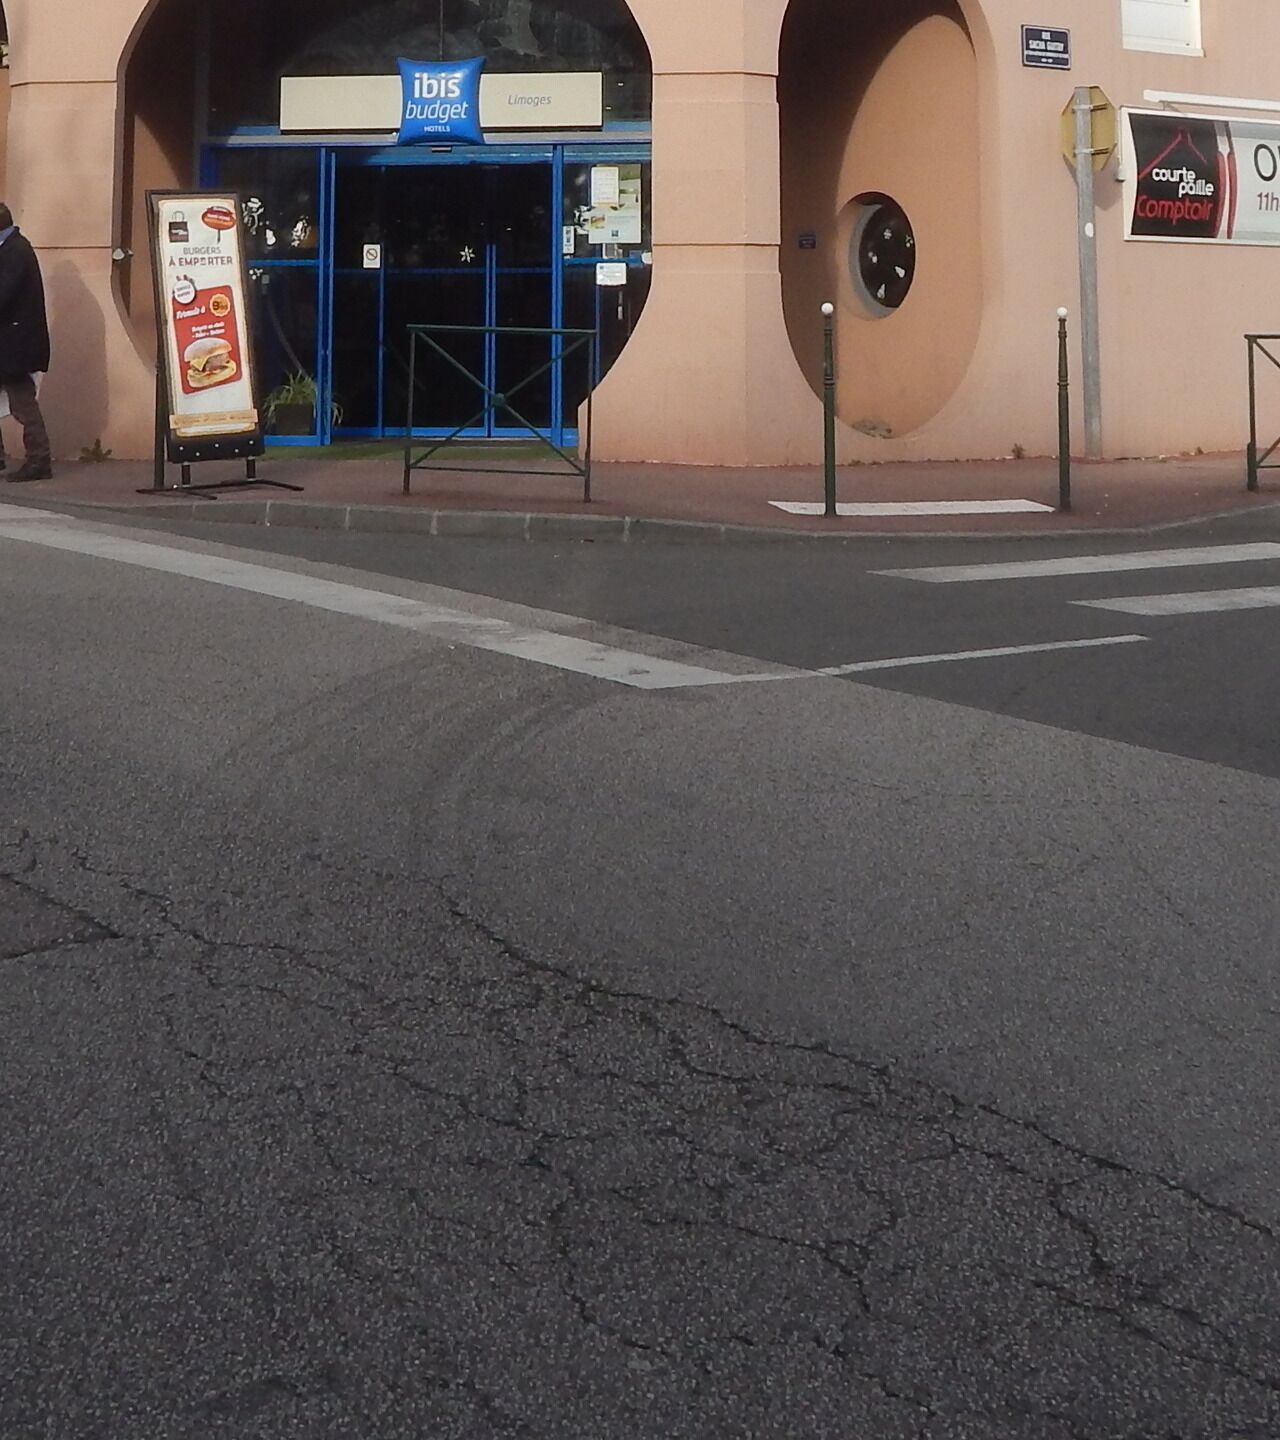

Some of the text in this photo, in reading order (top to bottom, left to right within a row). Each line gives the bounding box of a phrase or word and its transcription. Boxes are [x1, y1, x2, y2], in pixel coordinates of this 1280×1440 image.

[413, 72, 462, 98] ibis
[508, 94, 552, 107] Limoges
[405, 100, 469, 123] budget
[1152, 166, 1196, 183] courte
[1178, 178, 1214, 198] paille
[1136, 194, 1214, 225] Comptoir
[183, 246, 222, 255] BURGERS
